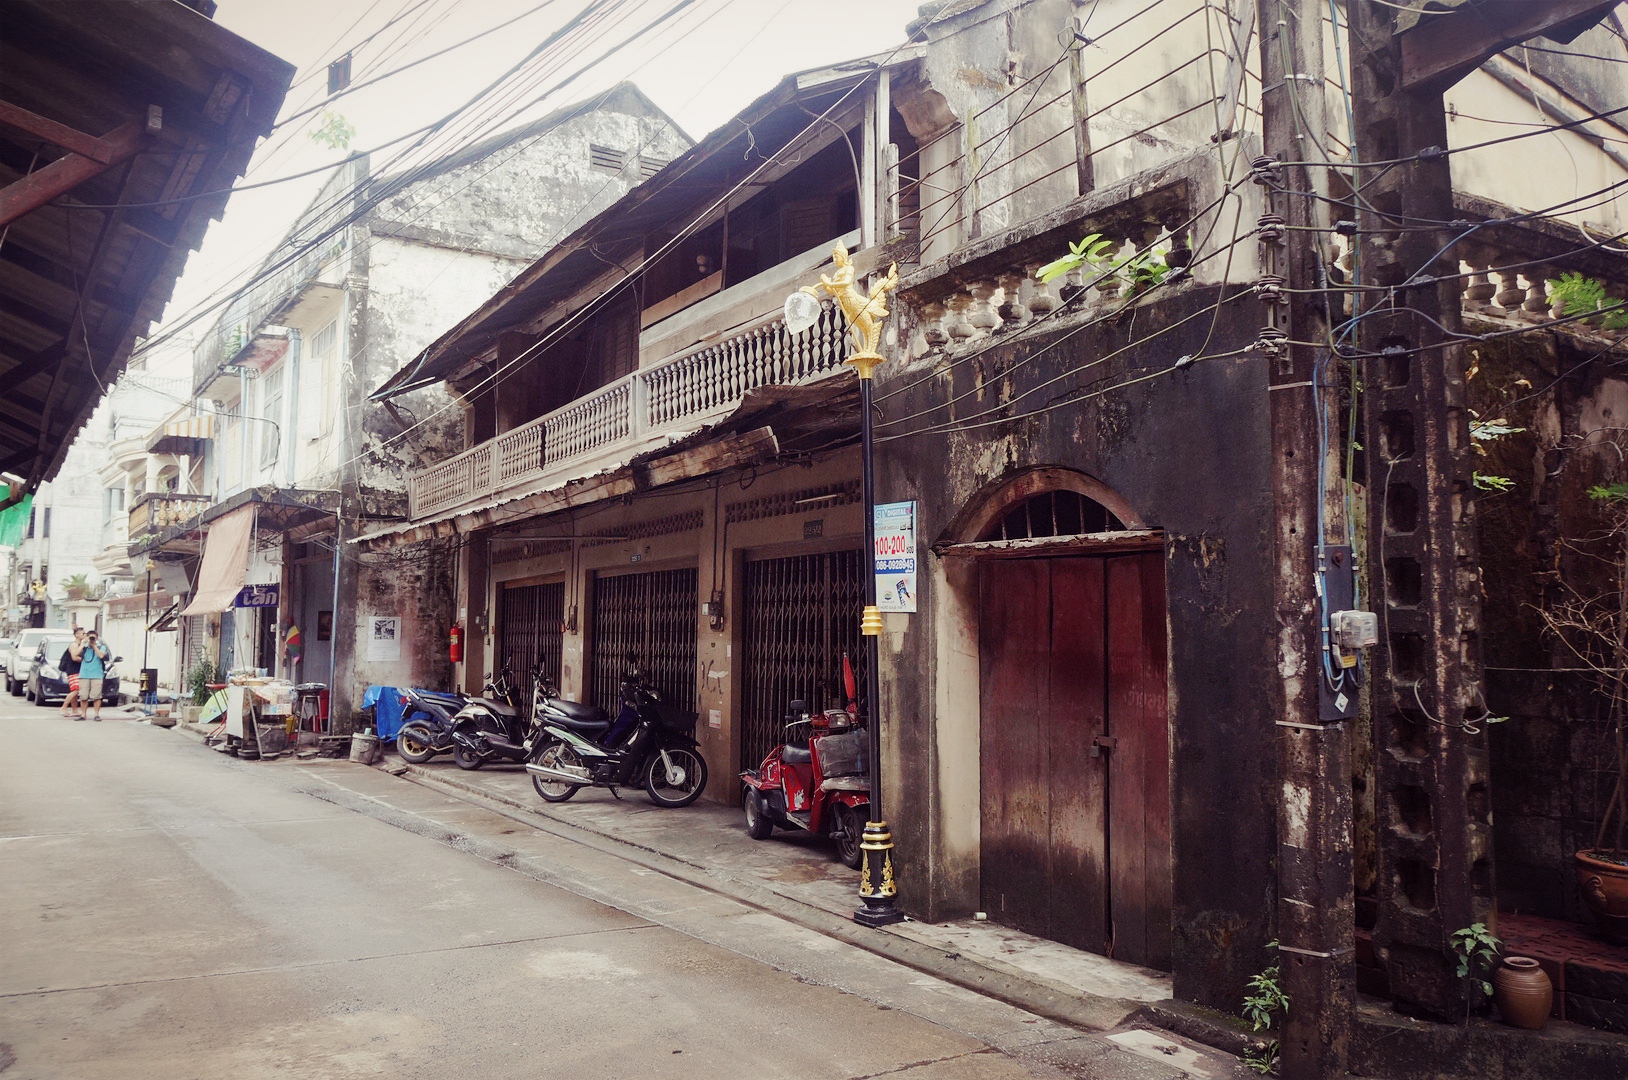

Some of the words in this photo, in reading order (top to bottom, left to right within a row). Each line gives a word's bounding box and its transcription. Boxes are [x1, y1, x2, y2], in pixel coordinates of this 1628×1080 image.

[887, 508, 906, 517] DIGITAL
[876, 535, 905, 555] 100-200
[243, 587, 277, 605] เล็ก
